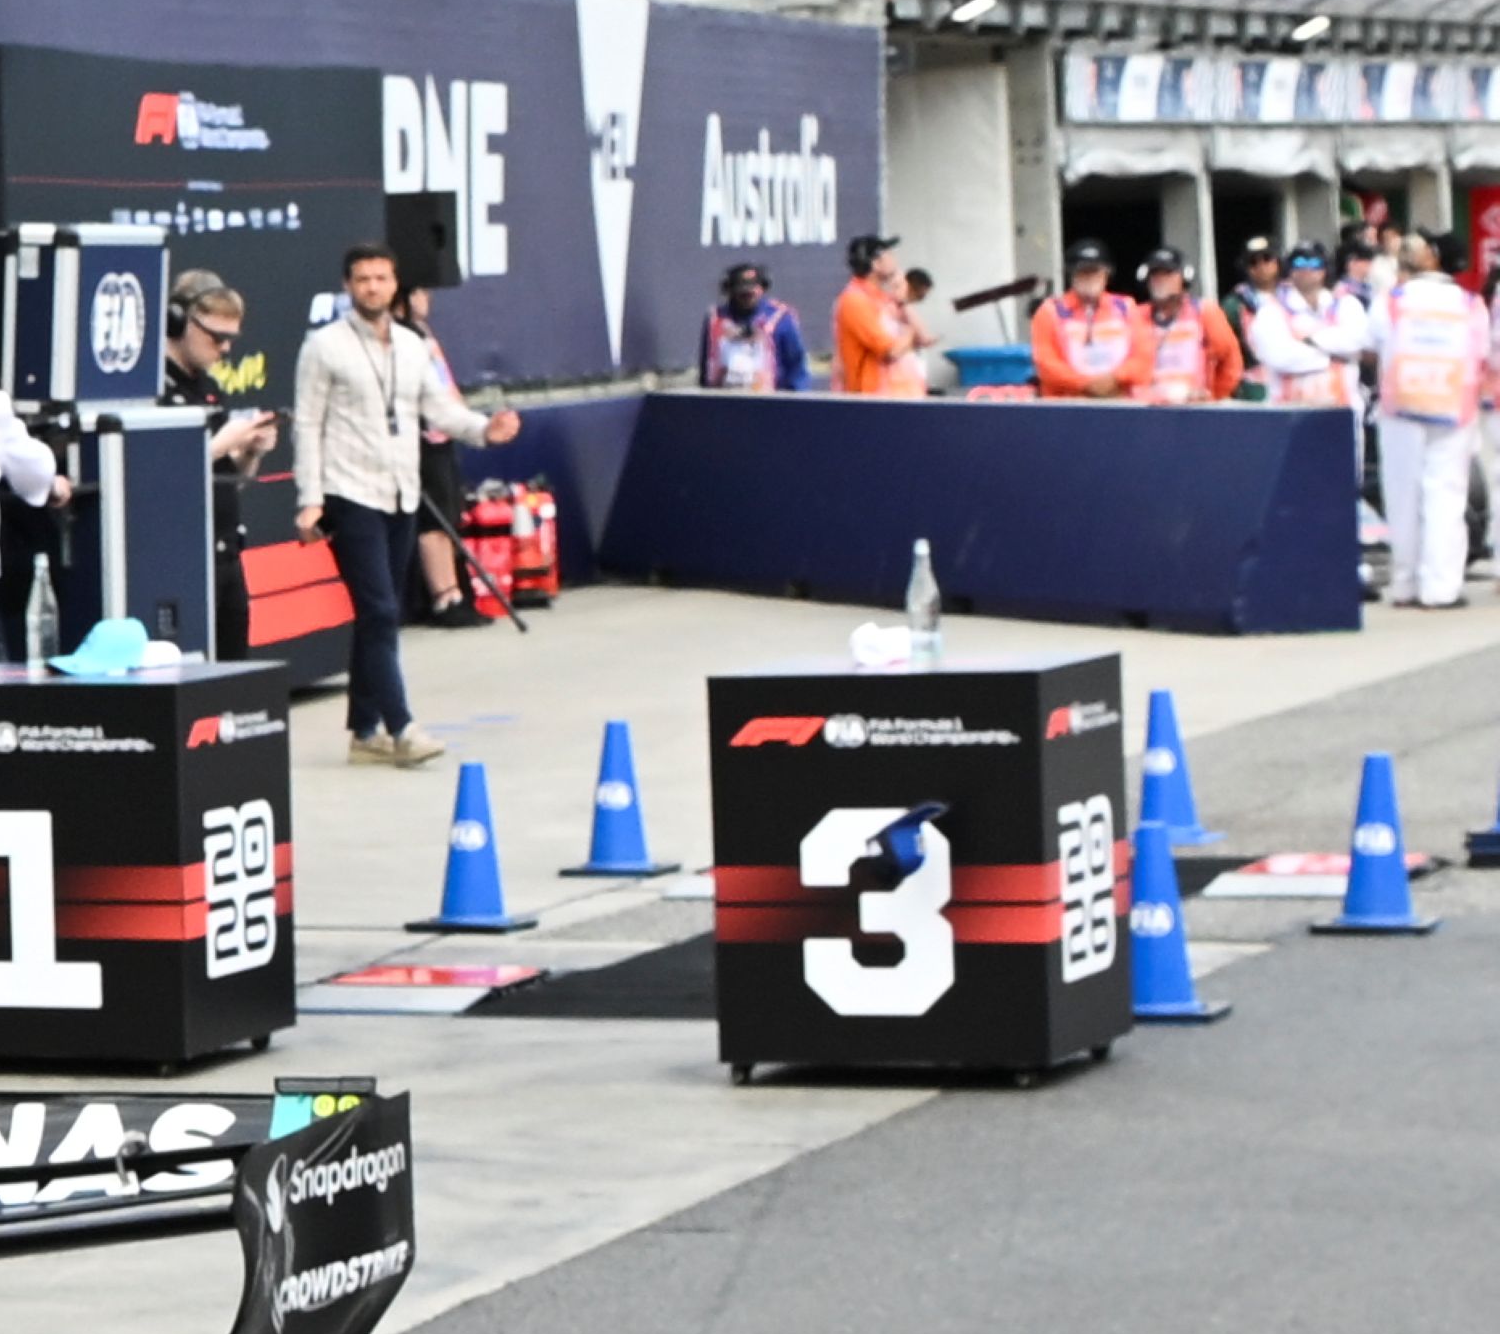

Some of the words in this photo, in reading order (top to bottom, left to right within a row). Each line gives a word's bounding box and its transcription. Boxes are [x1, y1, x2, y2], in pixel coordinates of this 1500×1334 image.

[699, 112, 838, 248] Australia
[94, 292, 144, 355] FIA
[799, 807, 956, 1017] 3
[289, 1138, 408, 1205] Snapdragon
[279, 1242, 408, 1315] CROWDSTRIKE
